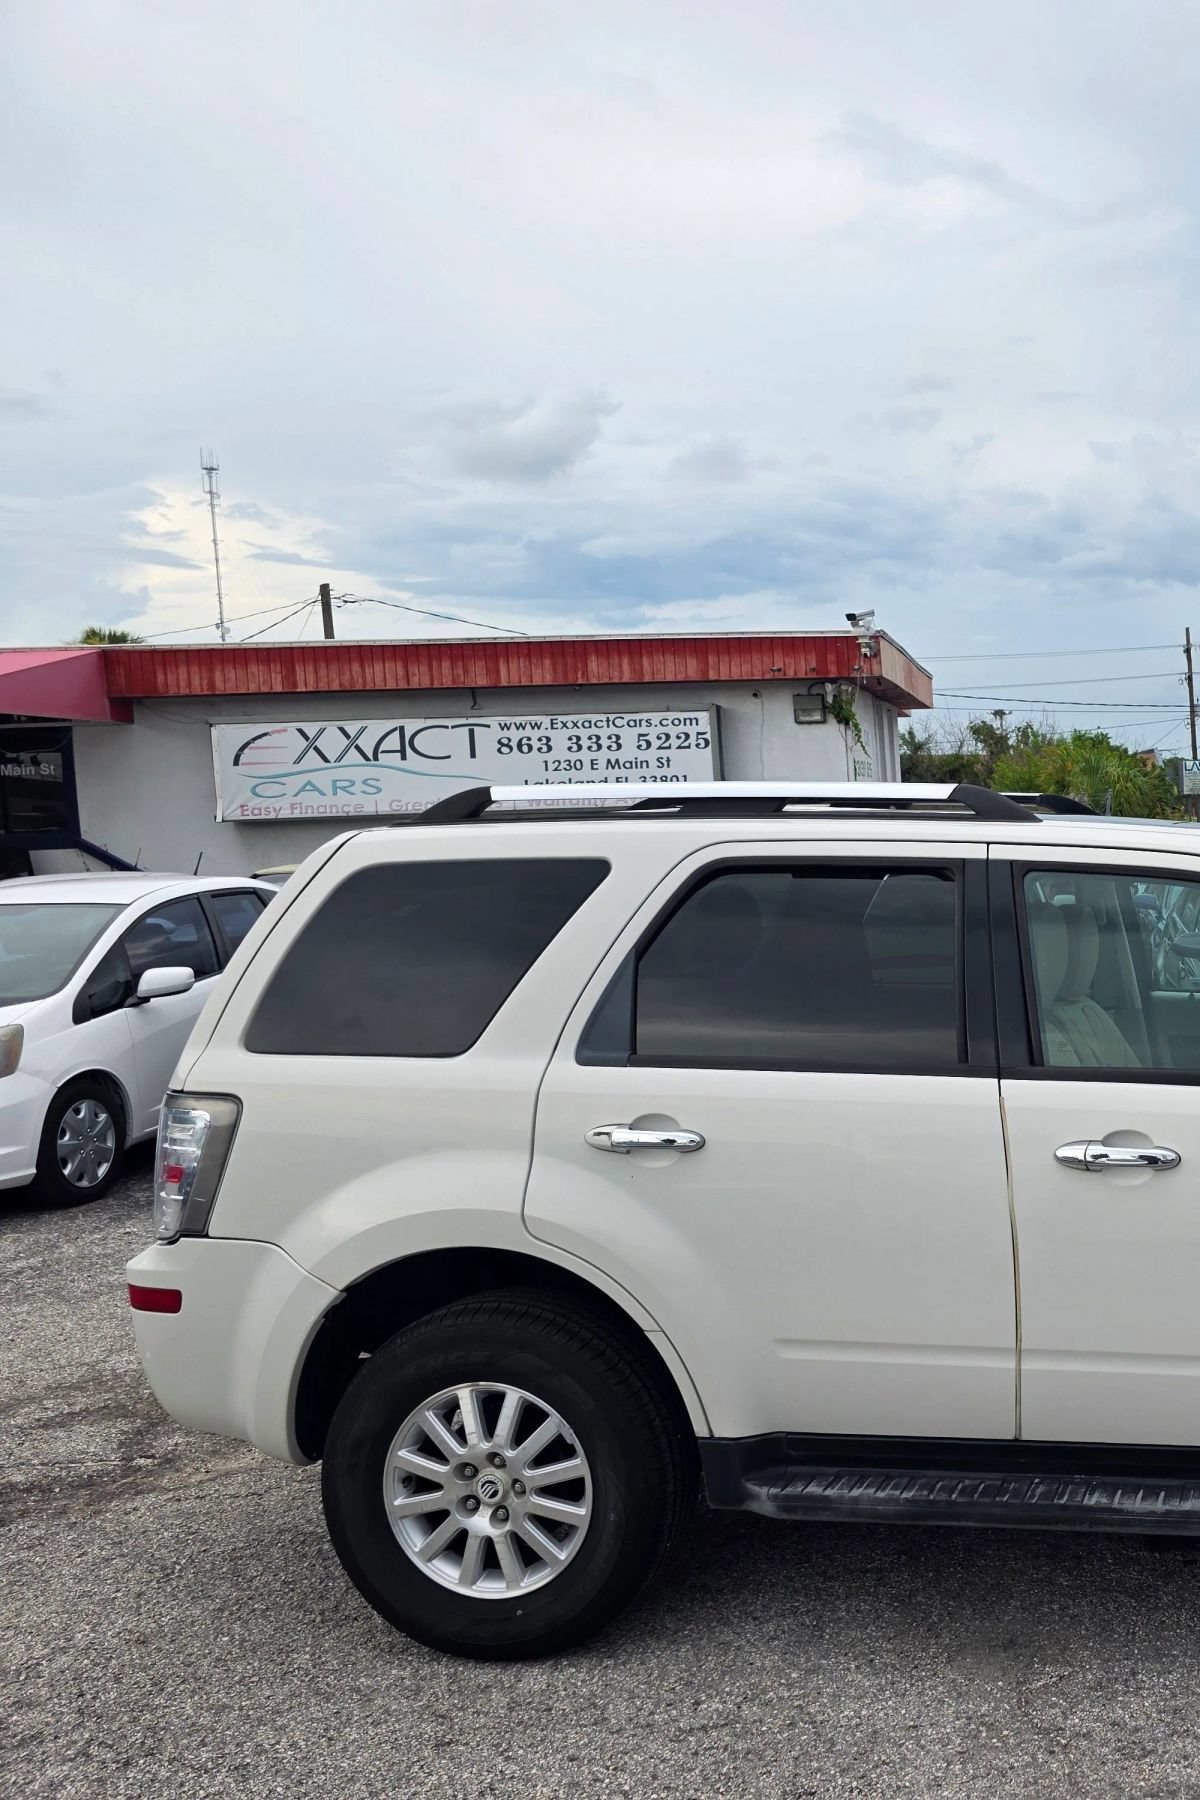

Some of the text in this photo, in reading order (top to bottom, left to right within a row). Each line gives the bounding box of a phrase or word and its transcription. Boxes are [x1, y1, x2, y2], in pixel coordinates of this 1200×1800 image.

[498, 716, 699, 731] www.ExxactCars.com
[232, 723, 491, 766] EXXACT
[496, 731, 710, 755] 863 333 5225
[0, 763, 56, 776] Main St
[542, 756, 672, 772] 1230 E Main St
[250, 777, 383, 798] CARS
[239, 803, 283, 818] Easy
[289, 802, 365, 816] Finance
